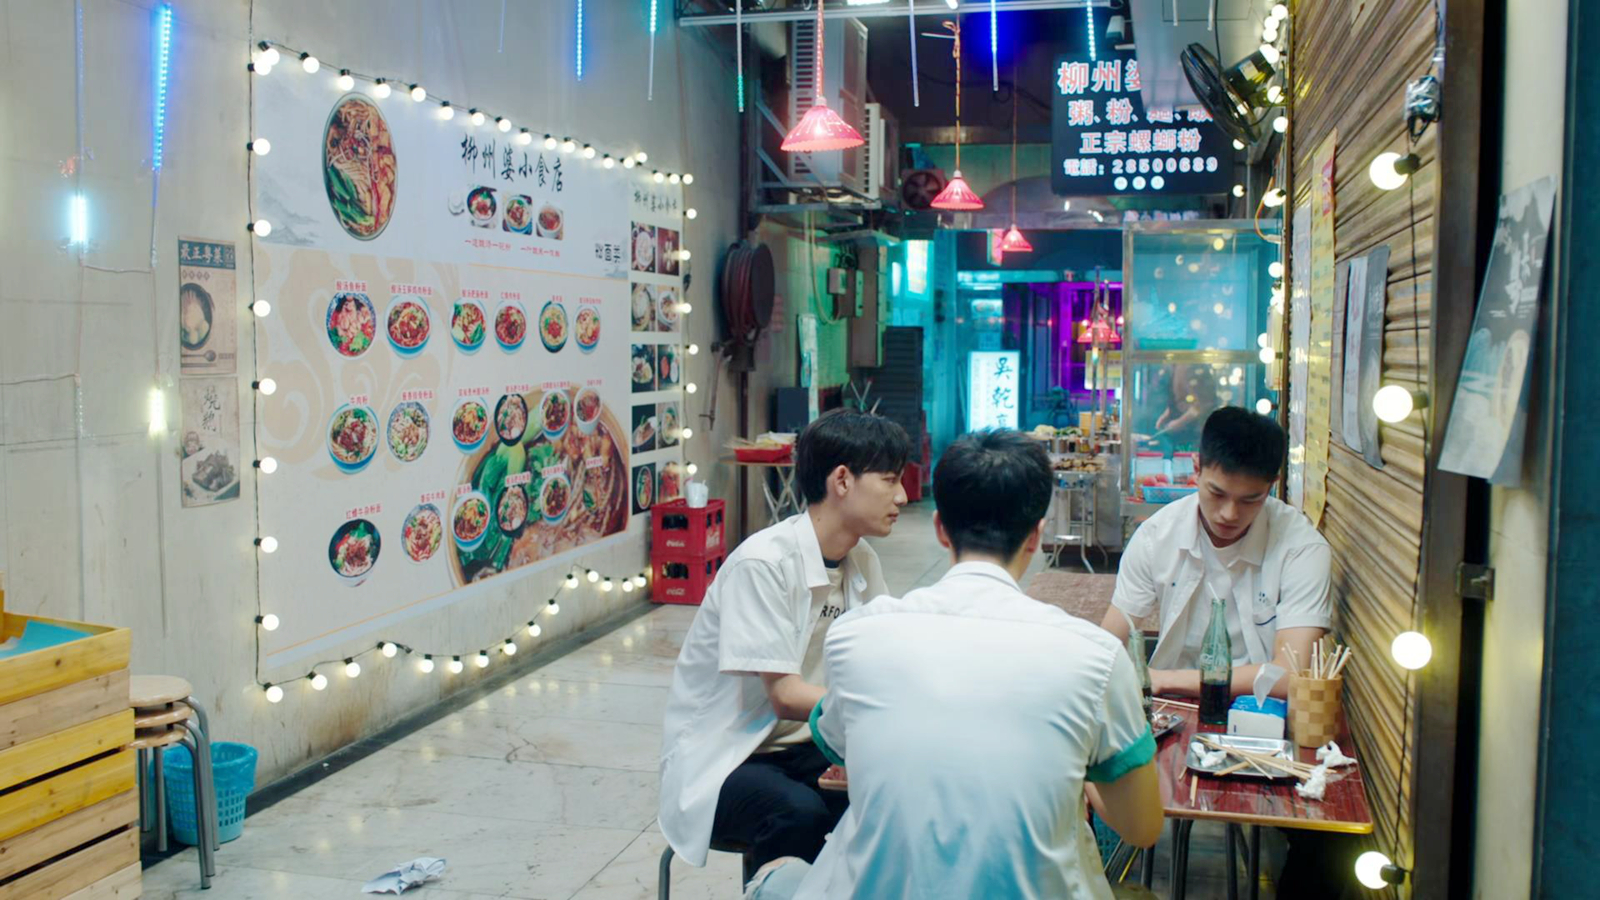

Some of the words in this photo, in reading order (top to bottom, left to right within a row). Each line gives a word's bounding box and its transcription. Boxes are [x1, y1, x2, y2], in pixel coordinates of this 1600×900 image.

[460, 133, 564, 192] 柳州婆小食店
